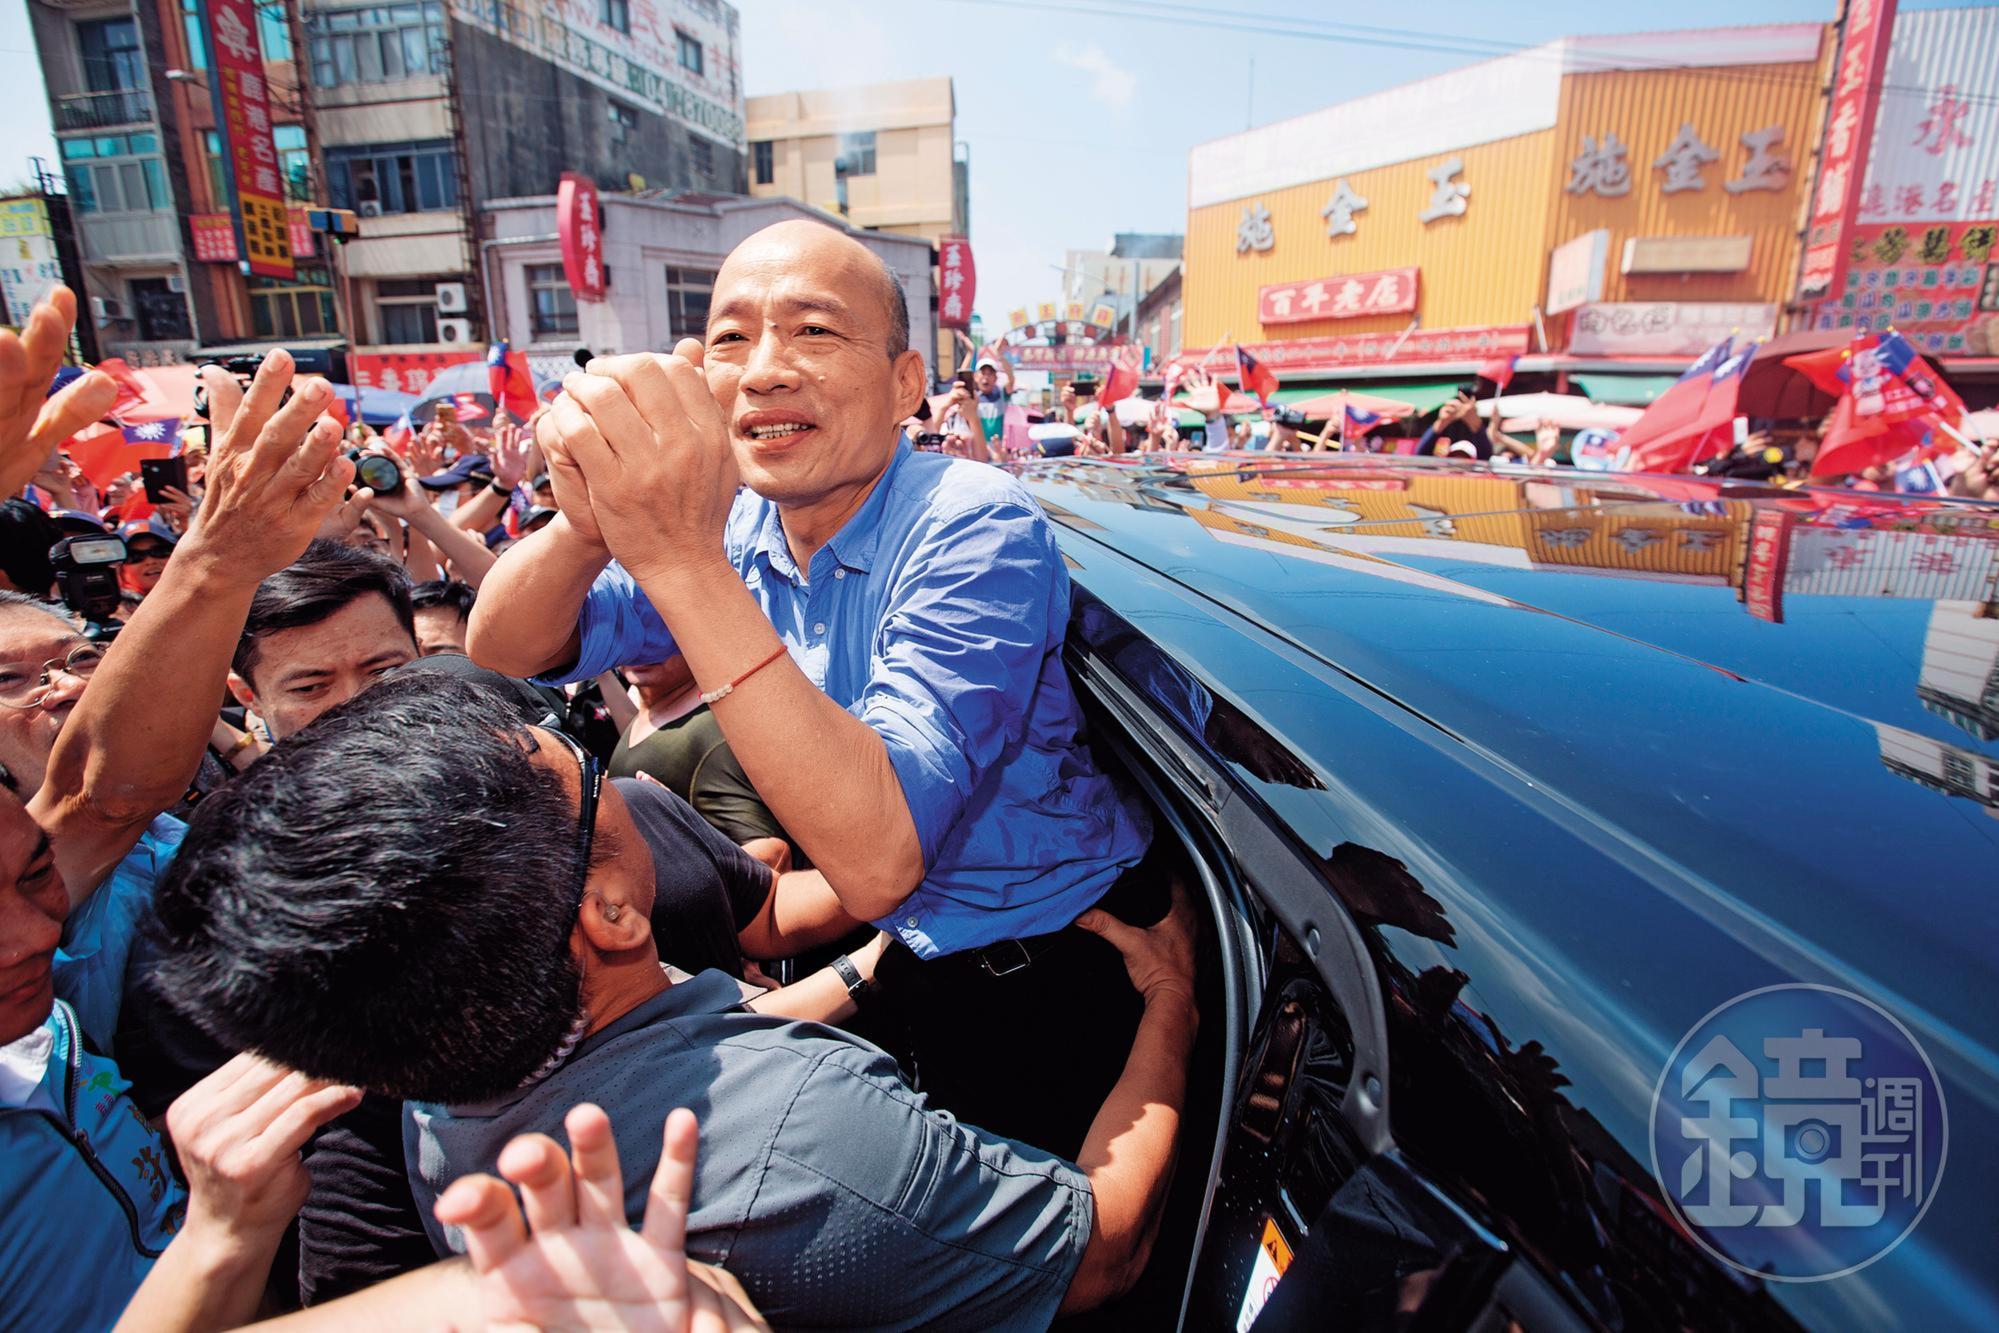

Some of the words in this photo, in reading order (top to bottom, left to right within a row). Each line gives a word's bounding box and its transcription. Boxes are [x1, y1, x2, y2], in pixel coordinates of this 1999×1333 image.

[1566, 121, 1791, 198] 施金玉
[1237, 157, 1473, 255] 施金玉
[1269, 275, 1402, 317] 百年老店
